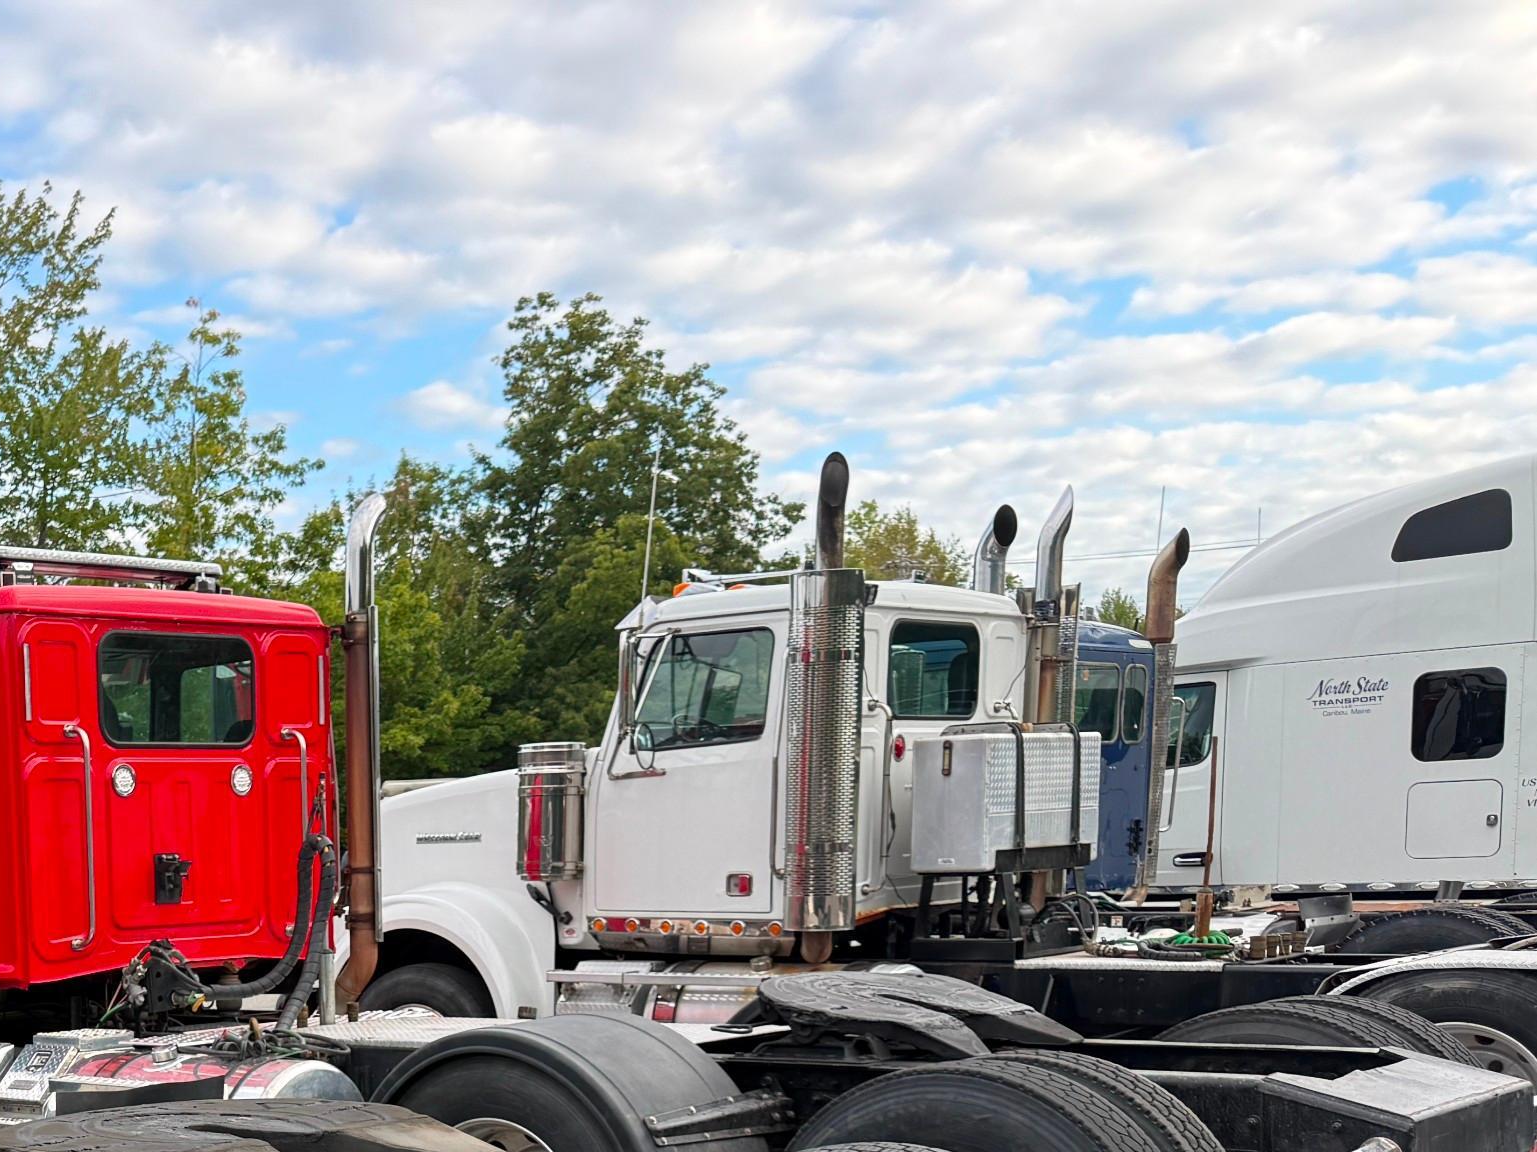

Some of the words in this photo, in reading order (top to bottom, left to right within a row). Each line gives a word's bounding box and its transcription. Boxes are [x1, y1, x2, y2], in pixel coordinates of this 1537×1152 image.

[1305, 678, 1351, 700] North
[1352, 676, 1389, 695] State
[1312, 695, 1384, 706] TRANSPORT
